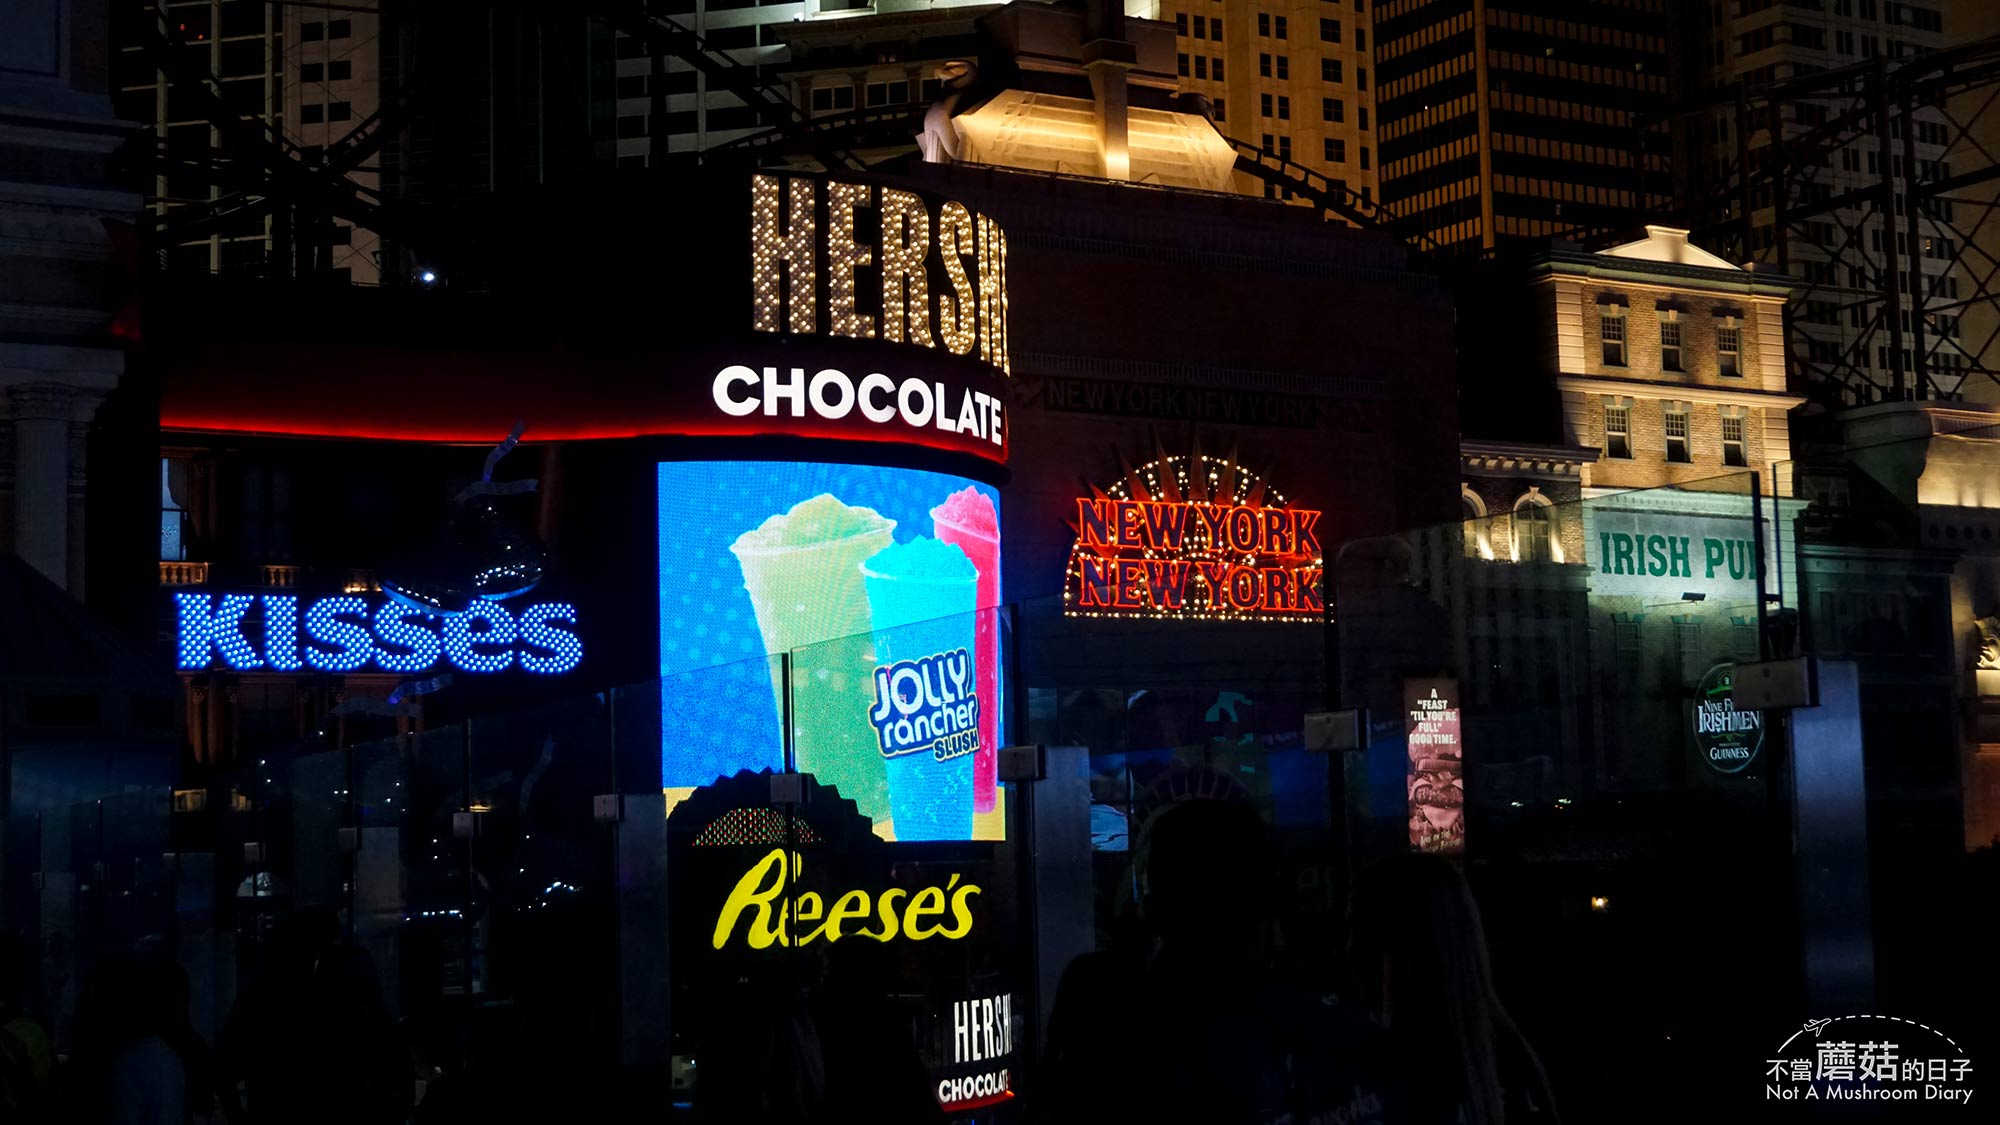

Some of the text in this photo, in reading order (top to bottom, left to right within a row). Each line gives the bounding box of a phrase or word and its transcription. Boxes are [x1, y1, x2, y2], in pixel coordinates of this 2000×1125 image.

[712, 365, 1002, 446] CHOCOLATE
[1077, 498, 1322, 559] NEW YORK
[1600, 531, 1692, 578] IRISH
[1079, 556, 1324, 612] NEW YORK
[874, 654, 967, 722] JOLLY
[1430, 687, 1439, 699] A
[883, 699, 976, 749] rancher
[933, 731, 979, 760] SLUSH
[1709, 746, 1750, 761] GUINNESS
